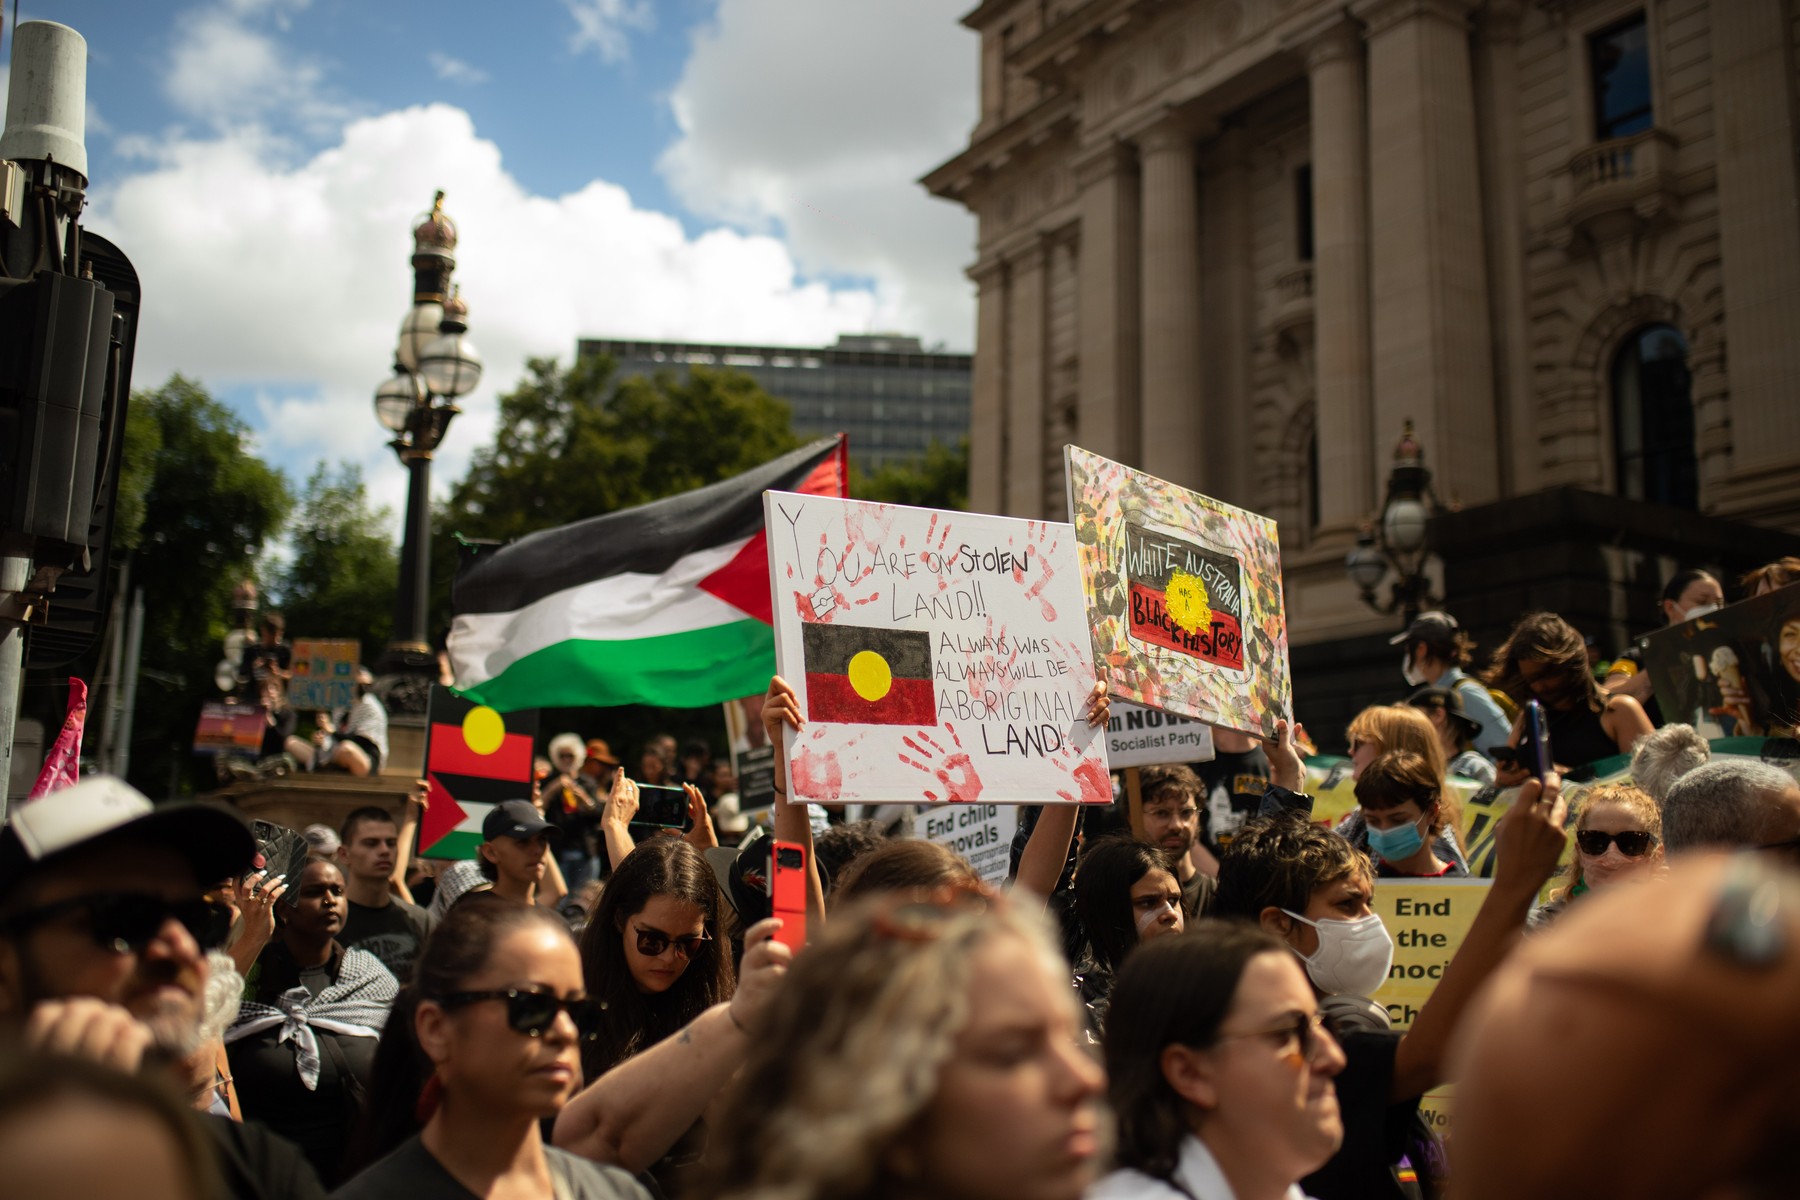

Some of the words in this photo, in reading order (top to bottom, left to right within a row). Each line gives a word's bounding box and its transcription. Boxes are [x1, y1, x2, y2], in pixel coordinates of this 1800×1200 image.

[778, 503, 861, 585] YOU
[871, 544, 918, 578] ARE
[926, 552, 952, 575] ON
[1126, 531, 1181, 577] WHITE
[1185, 550, 1241, 617] AUSTRALIA
[893, 580, 987, 622] LAND!!
[1178, 588, 1193, 599] HAS
[1184, 599, 1191, 612] A
[1133, 591, 1181, 643] BLACK
[1183, 621, 1243, 660] HISTORY
[940, 631, 1010, 656] ALWAYS
[1013, 635, 1051, 654] WAS
[935, 660, 1006, 682] ALWAYS
[1007, 661, 1043, 680] WILL
[1046, 659, 1068, 678] BE
[937, 689, 1086, 723] ABORIGINAL
[981, 723, 1067, 759] LAND!
[1111, 735, 1166, 752] Socialist
[1168, 732, 1201, 746] Party
[927, 812, 954, 839] End
[959, 804, 997, 828] child
[1395, 898, 1451, 917] End
[1396, 928, 1448, 948] the
